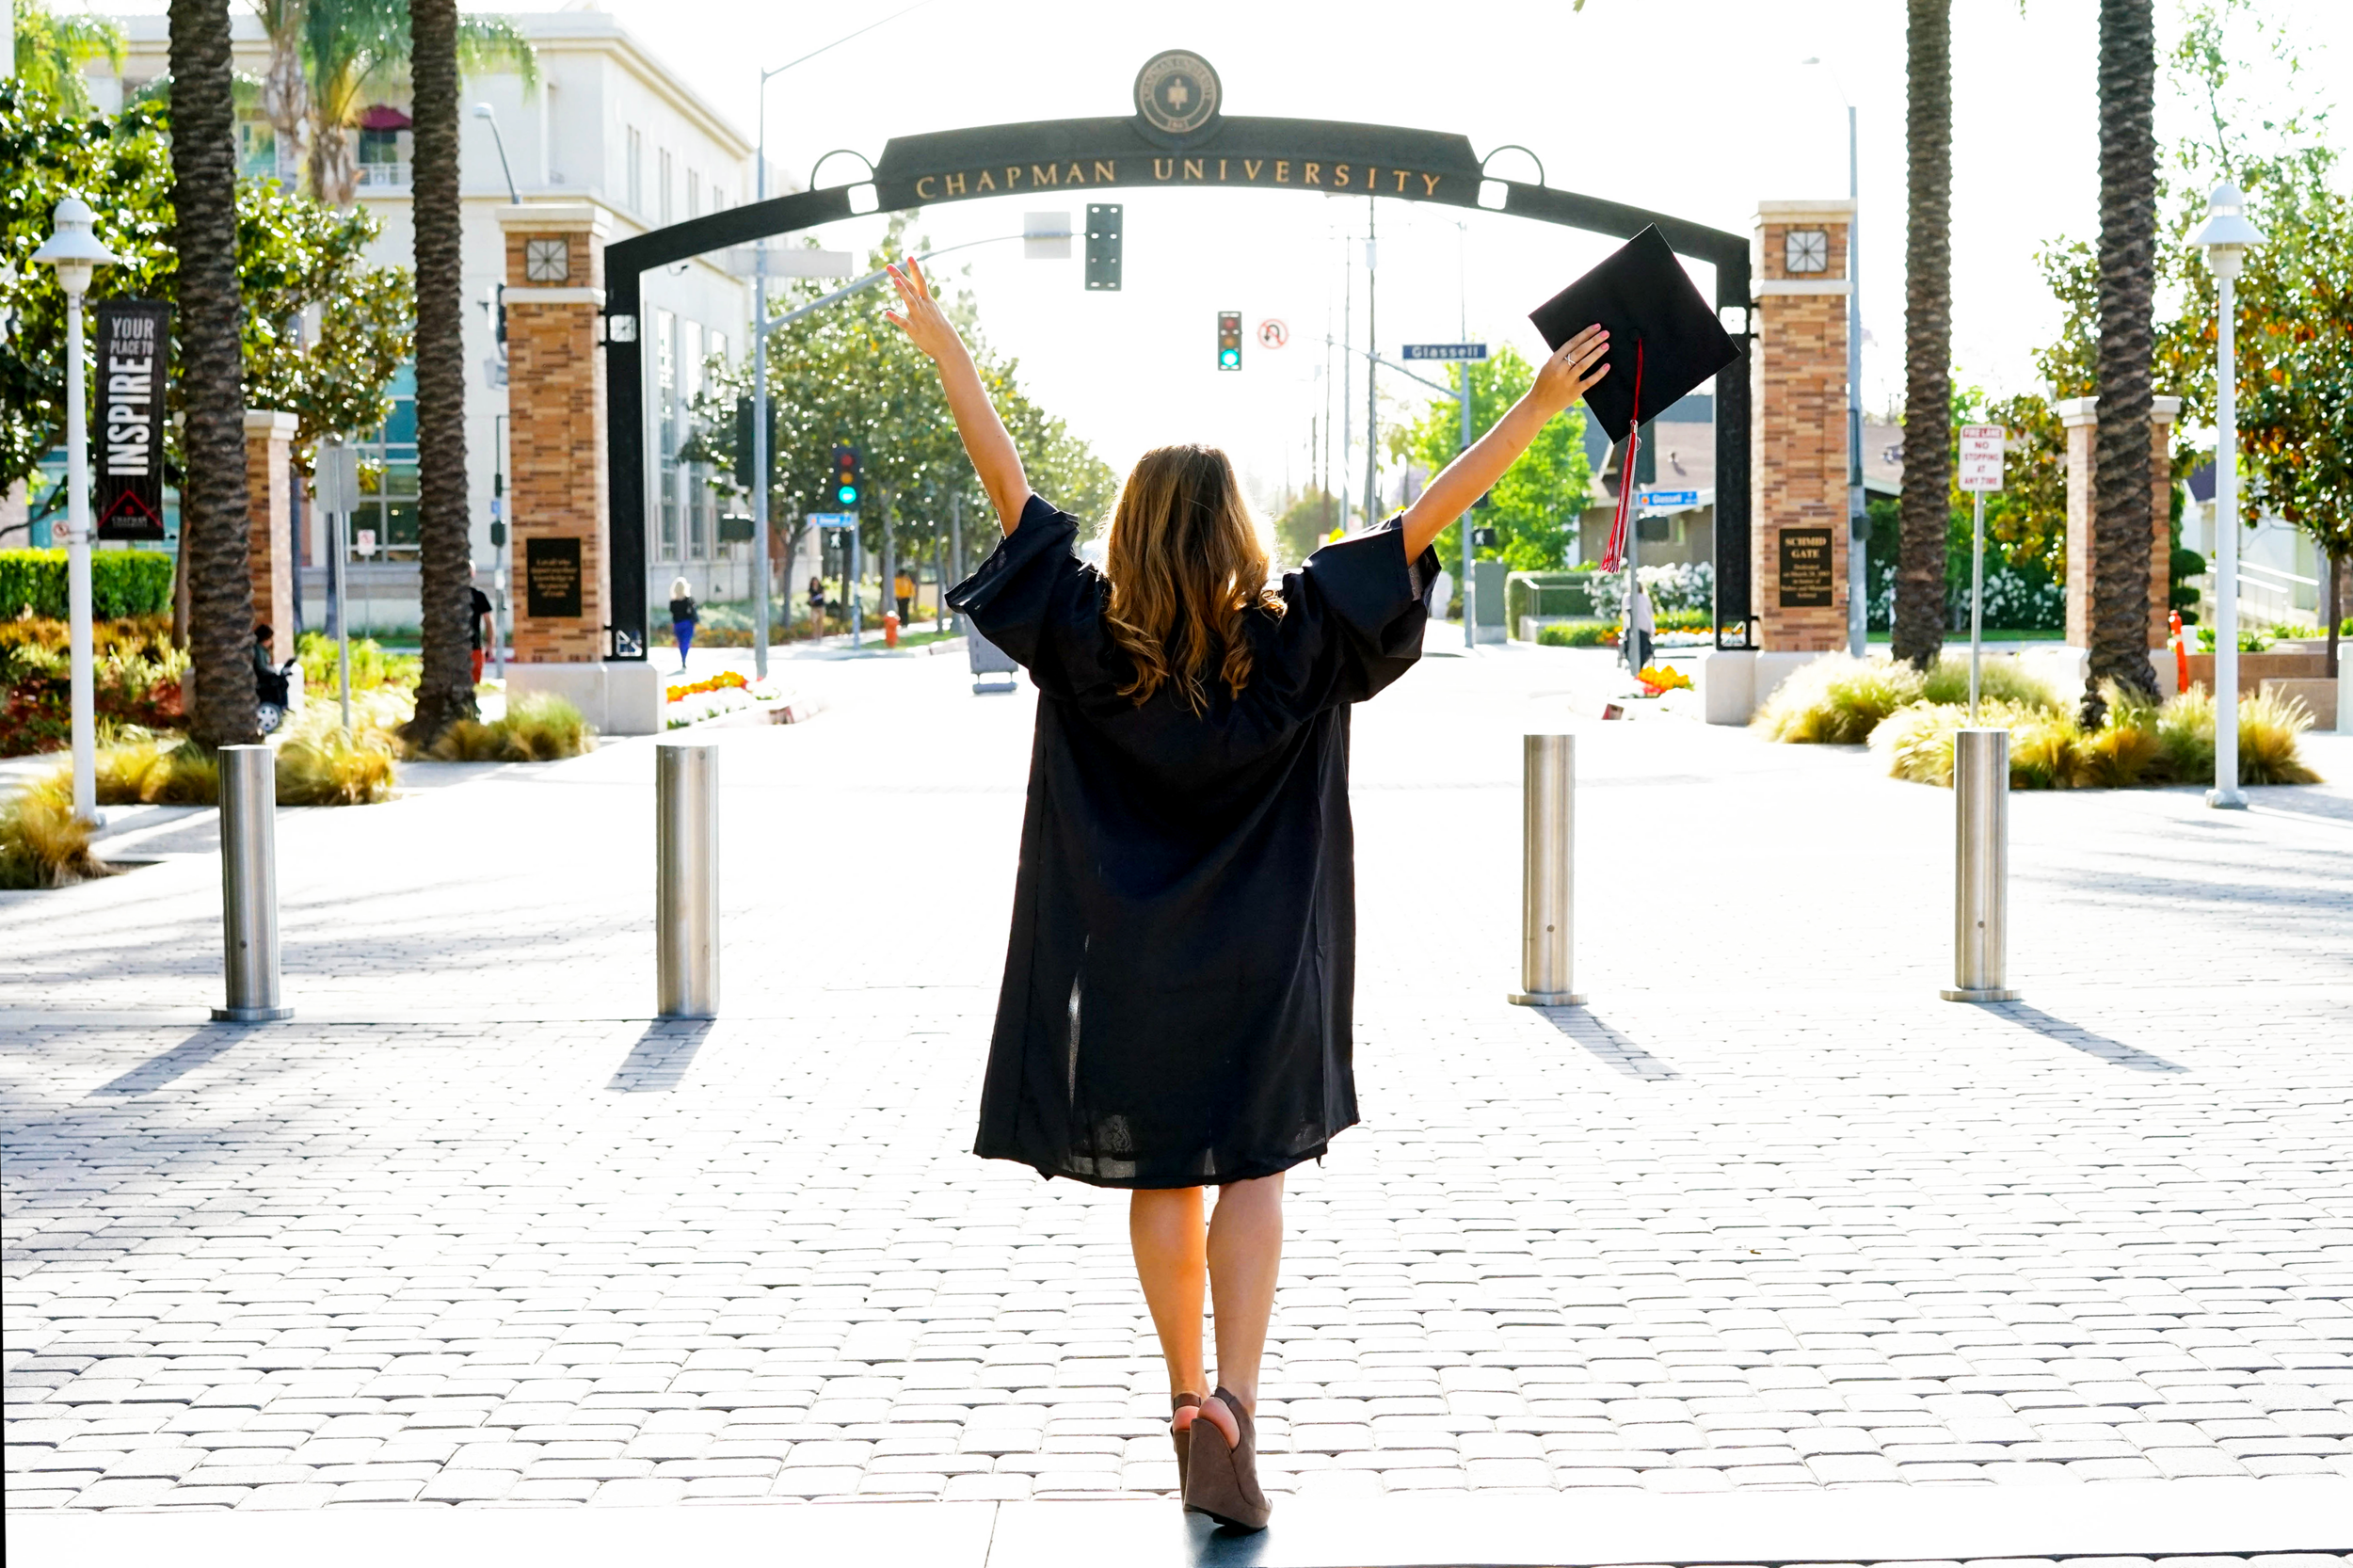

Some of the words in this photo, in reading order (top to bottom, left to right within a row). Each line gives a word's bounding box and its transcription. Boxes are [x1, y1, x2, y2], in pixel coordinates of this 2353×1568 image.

[916, 160, 1115, 200] CHAPMAN
[1153, 158, 1441, 196] UNIVERSITY
[112, 317, 154, 339] YOUR
[110, 340, 139, 355] PLACE
[141, 340, 153, 355] TO
[1412, 345, 1479, 359] Glassell
[107, 356, 152, 475] INSPIRE
[1981, 428, 2000, 437] LANE
[1975, 441, 1989, 450] NO
[1964, 453, 1998, 461] STOPPING
[1785, 536, 1827, 546] SCHMID
[1791, 549, 1820, 558] GATE
